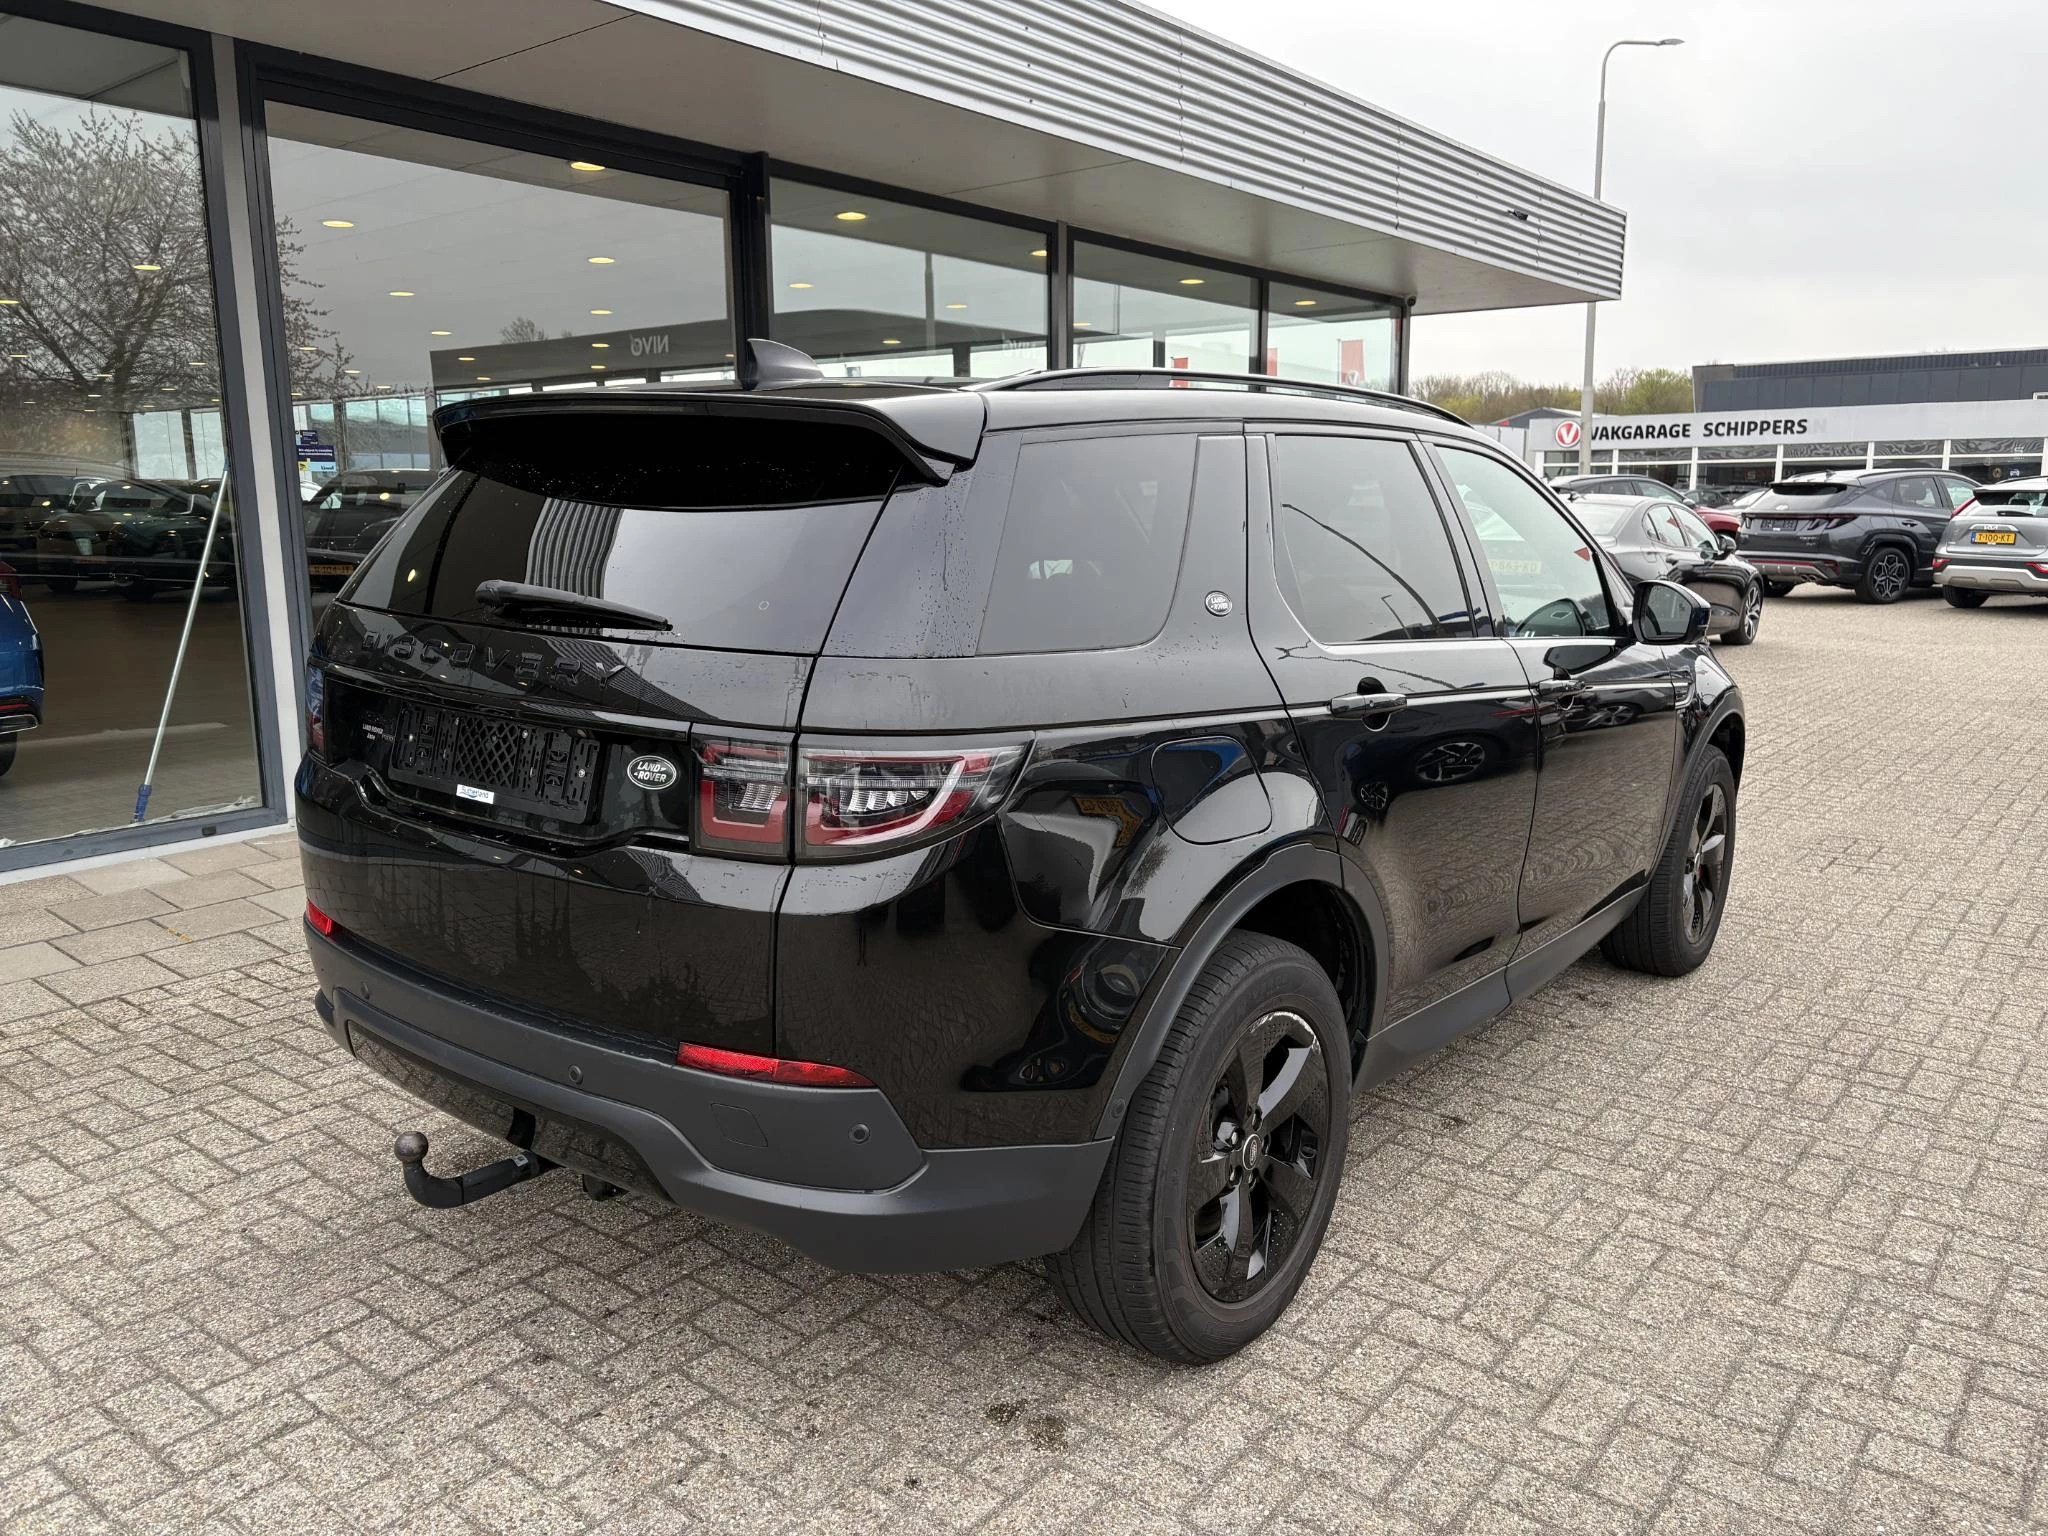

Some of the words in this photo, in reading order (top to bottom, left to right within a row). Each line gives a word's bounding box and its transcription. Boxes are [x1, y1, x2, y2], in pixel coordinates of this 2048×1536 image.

[1703, 418, 1808, 437] SCHIPPERS
[361, 630, 627, 690] DISCOVERY
[637, 761, 661, 773] LAND
[637, 770, 667, 783] ROVER
